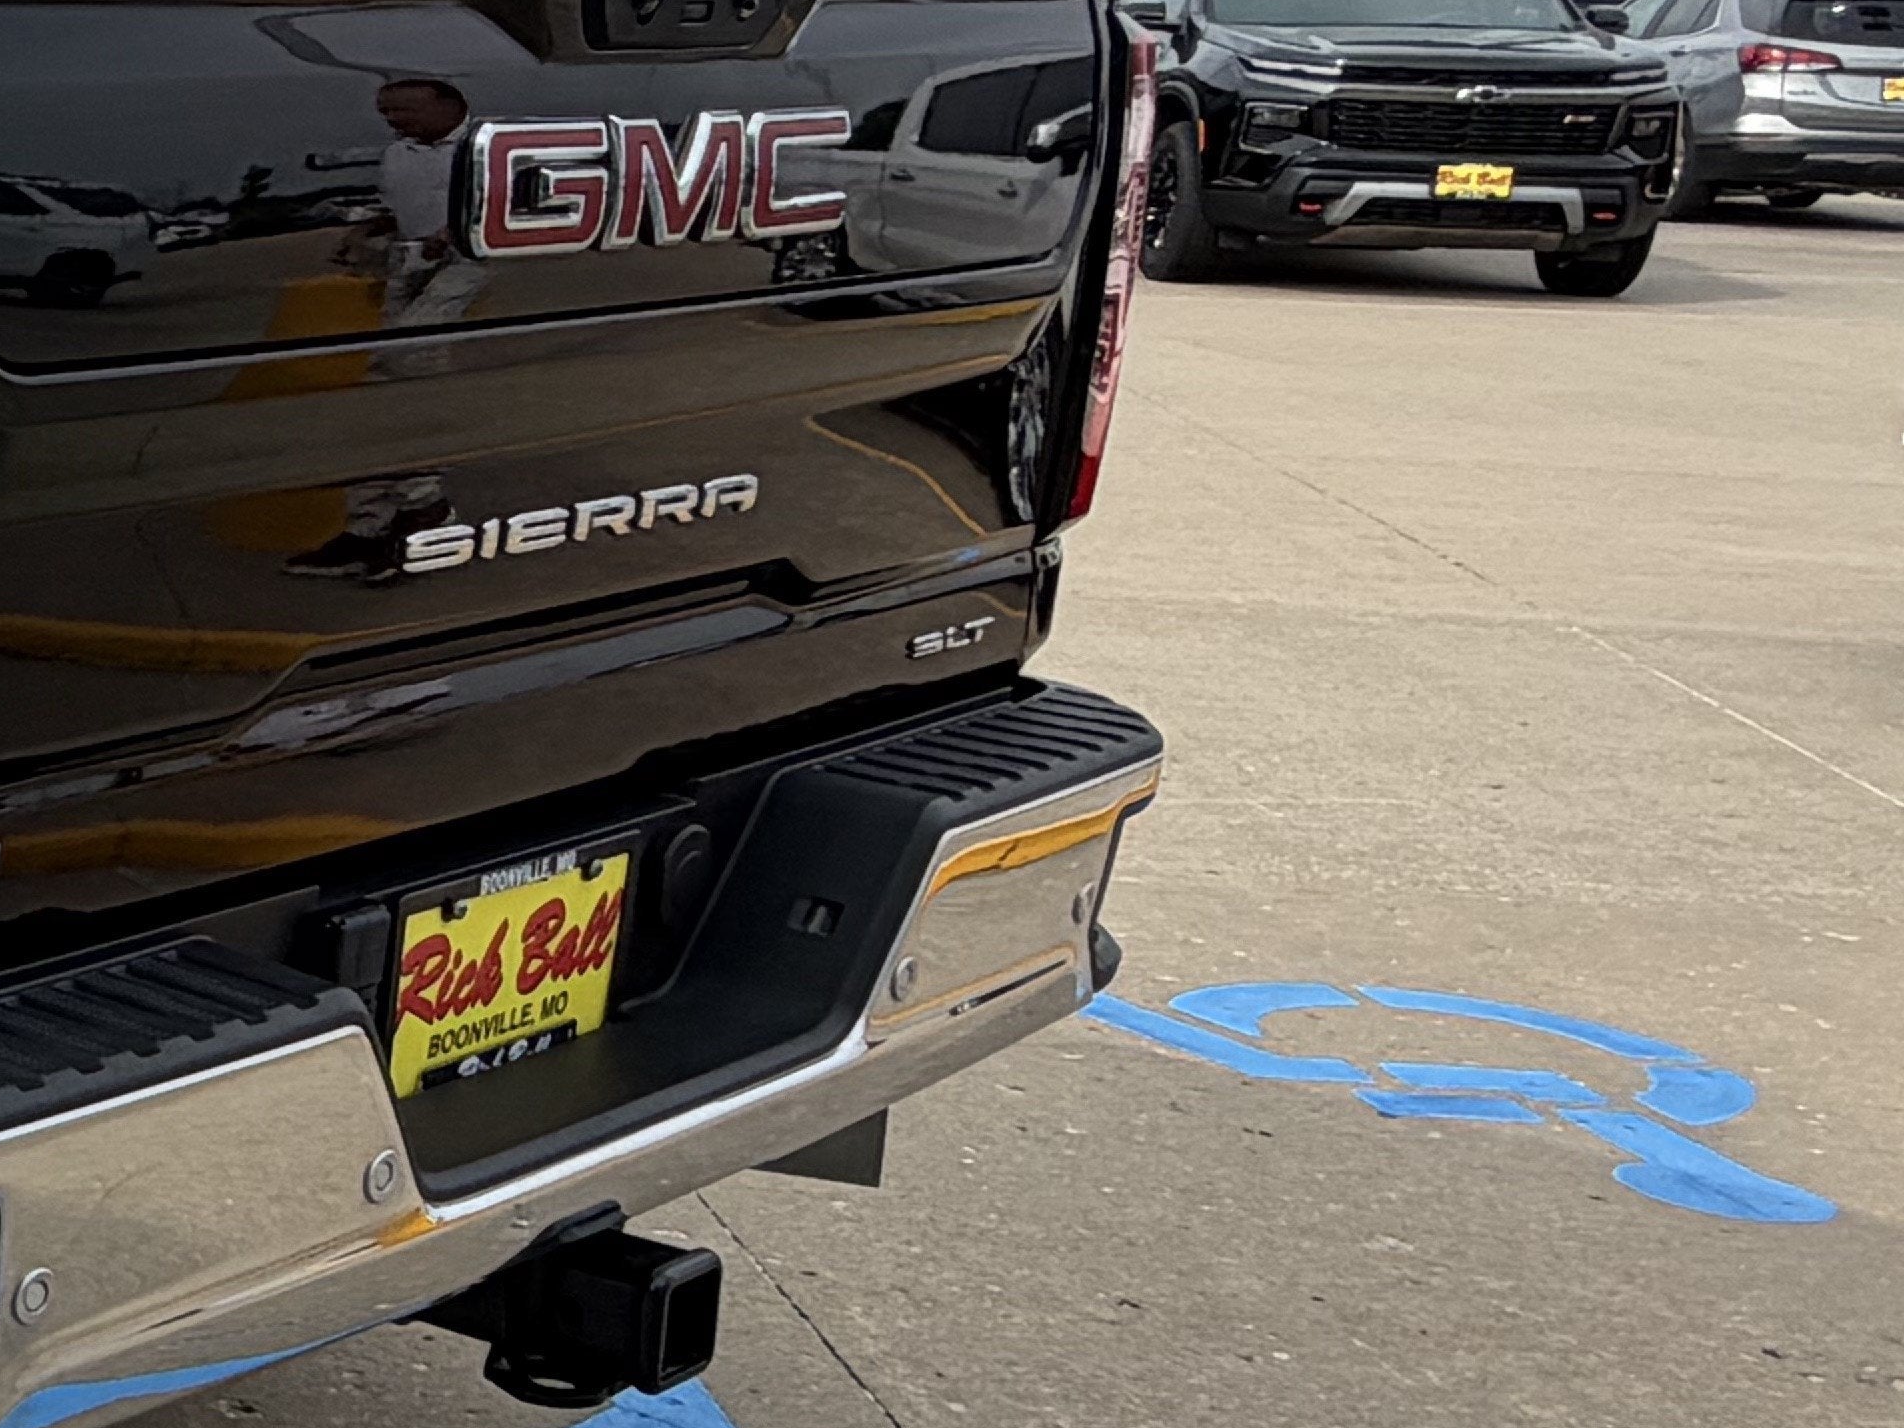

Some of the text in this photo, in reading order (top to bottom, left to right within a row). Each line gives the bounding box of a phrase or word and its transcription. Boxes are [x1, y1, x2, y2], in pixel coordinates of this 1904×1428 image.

[454, 108, 852, 259] GMC
[400, 472, 760, 575] SIERRA
[905, 615, 995, 661] SLT
[396, 888, 623, 1024] Rick Ball
[539, 991, 569, 1016] MO
